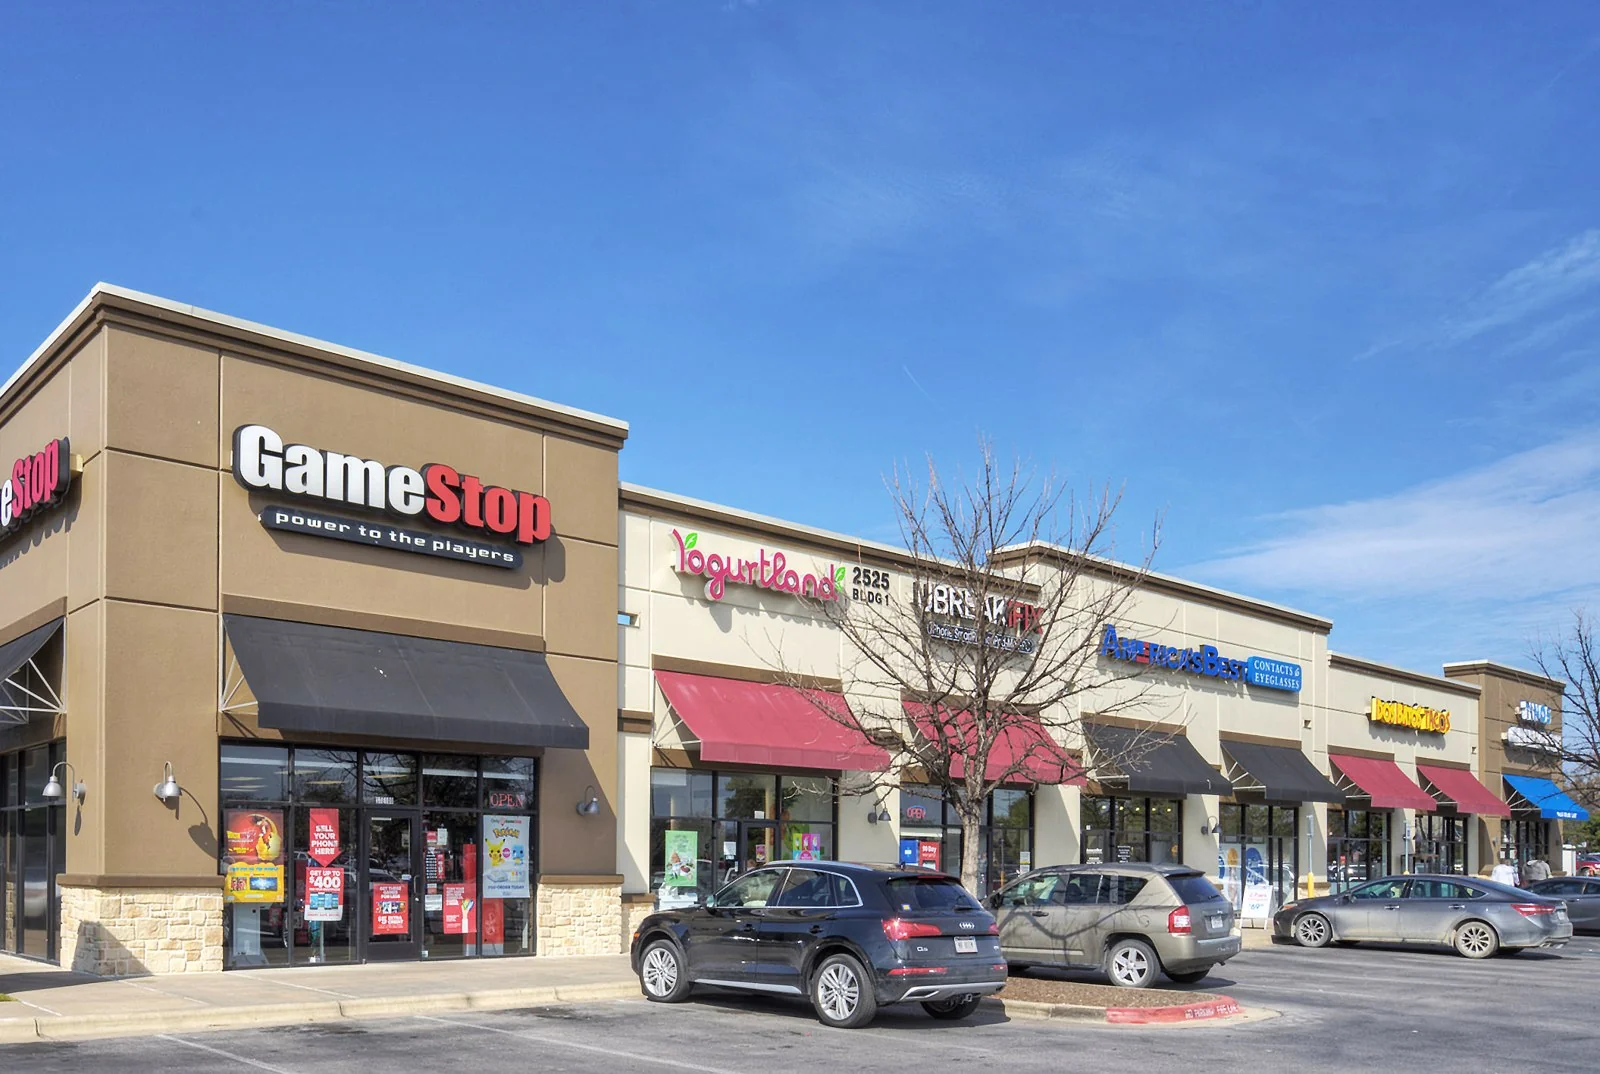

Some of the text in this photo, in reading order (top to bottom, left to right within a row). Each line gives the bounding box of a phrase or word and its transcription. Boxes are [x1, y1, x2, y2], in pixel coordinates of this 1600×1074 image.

[240, 425, 551, 544] GameStop
[275, 512, 514, 562] power to the players
[672, 528, 838, 601] Yogurtland
[852, 566, 890, 591] 2525
[852, 588, 889, 606] BLDG 1
[1253, 659, 1300, 677] CONTACTS &
[1254, 672, 1300, 689] EYEGLASSES
[490, 793, 524, 808] OPEN
[907, 807, 925, 819] OPEN
[315, 824, 334, 833] SELL
[309, 876, 341, 888] $400
